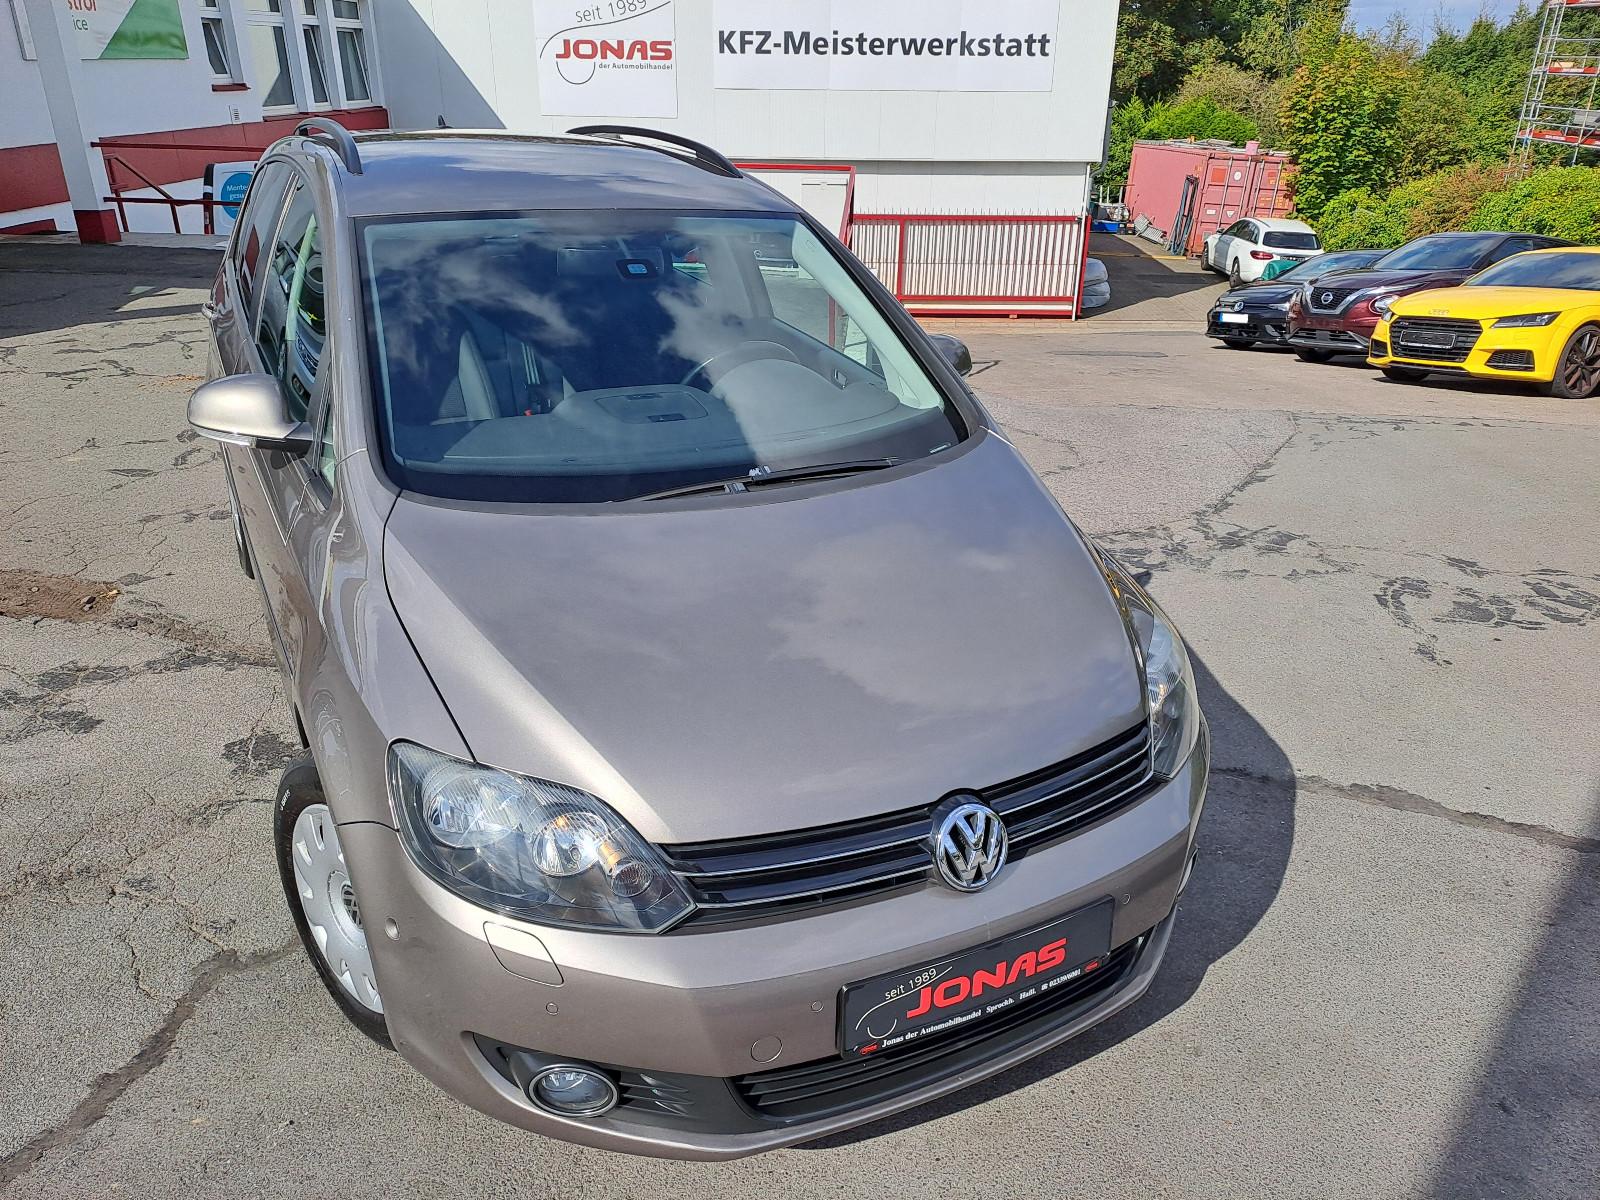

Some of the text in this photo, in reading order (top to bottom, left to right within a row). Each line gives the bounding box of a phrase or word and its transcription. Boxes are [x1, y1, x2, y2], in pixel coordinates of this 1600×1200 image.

[575, 0, 647, 23] seit 1989
[555, 39, 673, 60] JONAS
[718, 30, 1050, 57] KFZ-Meisterwerkstatt
[612, 62, 673, 71] Automobilhandel
[884, 968, 938, 1000] seit 1989
[906, 937, 1067, 1018] JONAS
[881, 1035, 904, 1048] Jonas
[905, 1031, 919, 1040] der
[919, 1009, 983, 1036] Automobilhandel
[985, 996, 1016, 1014] Sprockh.
